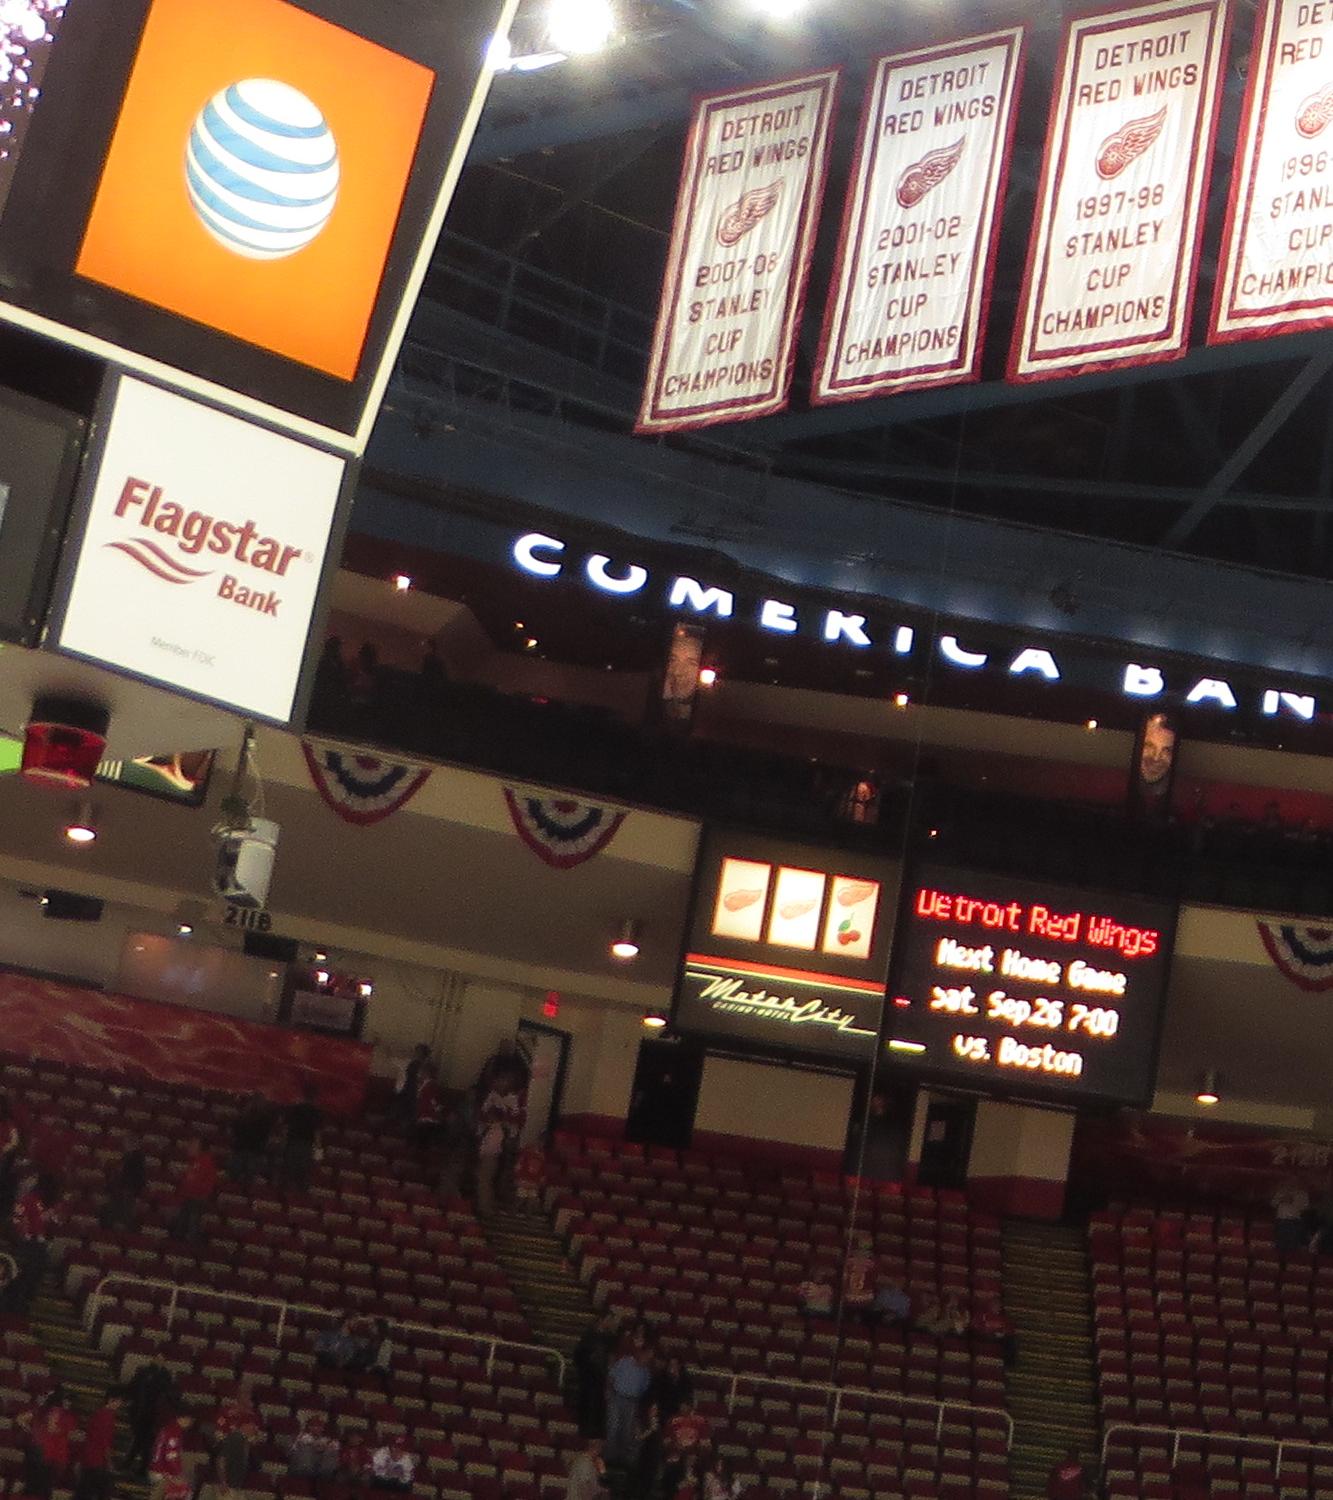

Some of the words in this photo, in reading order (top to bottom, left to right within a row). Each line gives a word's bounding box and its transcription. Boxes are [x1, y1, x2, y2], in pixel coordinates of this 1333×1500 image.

[1096, 30, 1190, 70] DETROIT
[1281, 40, 1322, 65] RED
[901, 63, 989, 101] DETROIT
[1078, 80, 1121, 106] RED
[1133, 64, 1197, 96] WINGS
[722, 105, 805, 142] DETROIT
[883, 111, 923, 136] RED
[934, 96, 995, 126] WINGS
[705, 152, 744, 178] RED
[753, 137, 808, 168] WINGS
[1076, 185, 1164, 220] 1997-98
[877, 217, 960, 251] 2001-02
[1066, 220, 1164, 258] STANLEY
[1289, 224, 1333, 251] CUP
[696, 254, 777, 287] 2007-08
[868, 252, 960, 287] STANLEY
[1087, 264, 1130, 291] CUP
[689, 290, 771, 322] STANLEY
[887, 293, 927, 319] CUP
[1043, 296, 1164, 334] CHAMPIONS
[705, 330, 742, 355] CUP
[845, 326, 958, 364] CHAMPIONS
[665, 359, 772, 396] CHAMPIONS
[114, 476, 303, 576] Flagstar
[218, 574, 283, 617] Bank
[1029, 905, 1081, 941] Red
[1088, 916, 1158, 957] Wings
[936, 937, 994, 973] Next
[1001, 949, 1062, 984] Home
[1068, 960, 1127, 995] Game
[1068, 1004, 1119, 1038] 7:00
[954, 1034, 991, 1060] vs.
[998, 1036, 1083, 1076] Boston
